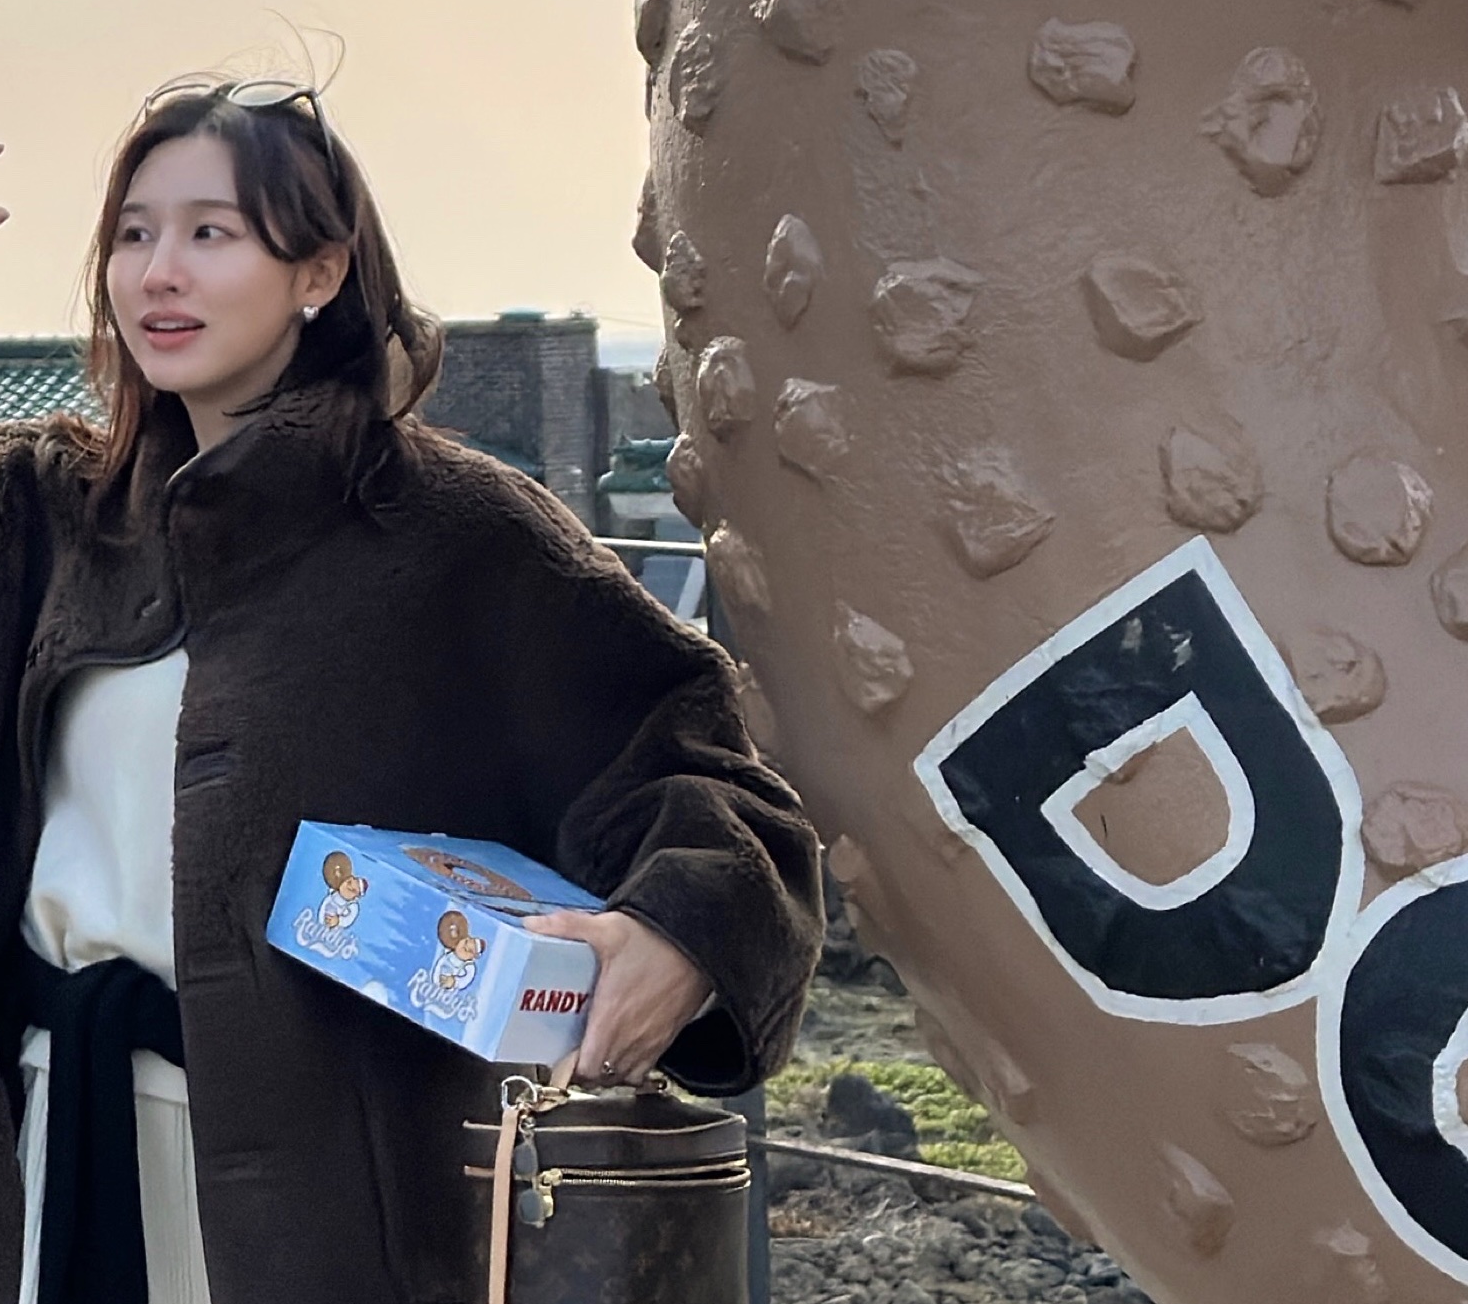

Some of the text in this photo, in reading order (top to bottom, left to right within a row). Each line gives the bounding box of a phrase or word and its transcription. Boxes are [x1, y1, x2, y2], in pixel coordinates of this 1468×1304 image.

[293, 907, 360, 960] Randy's
[407, 967, 479, 1022] Randy's
[519, 989, 590, 1014] RANDY
